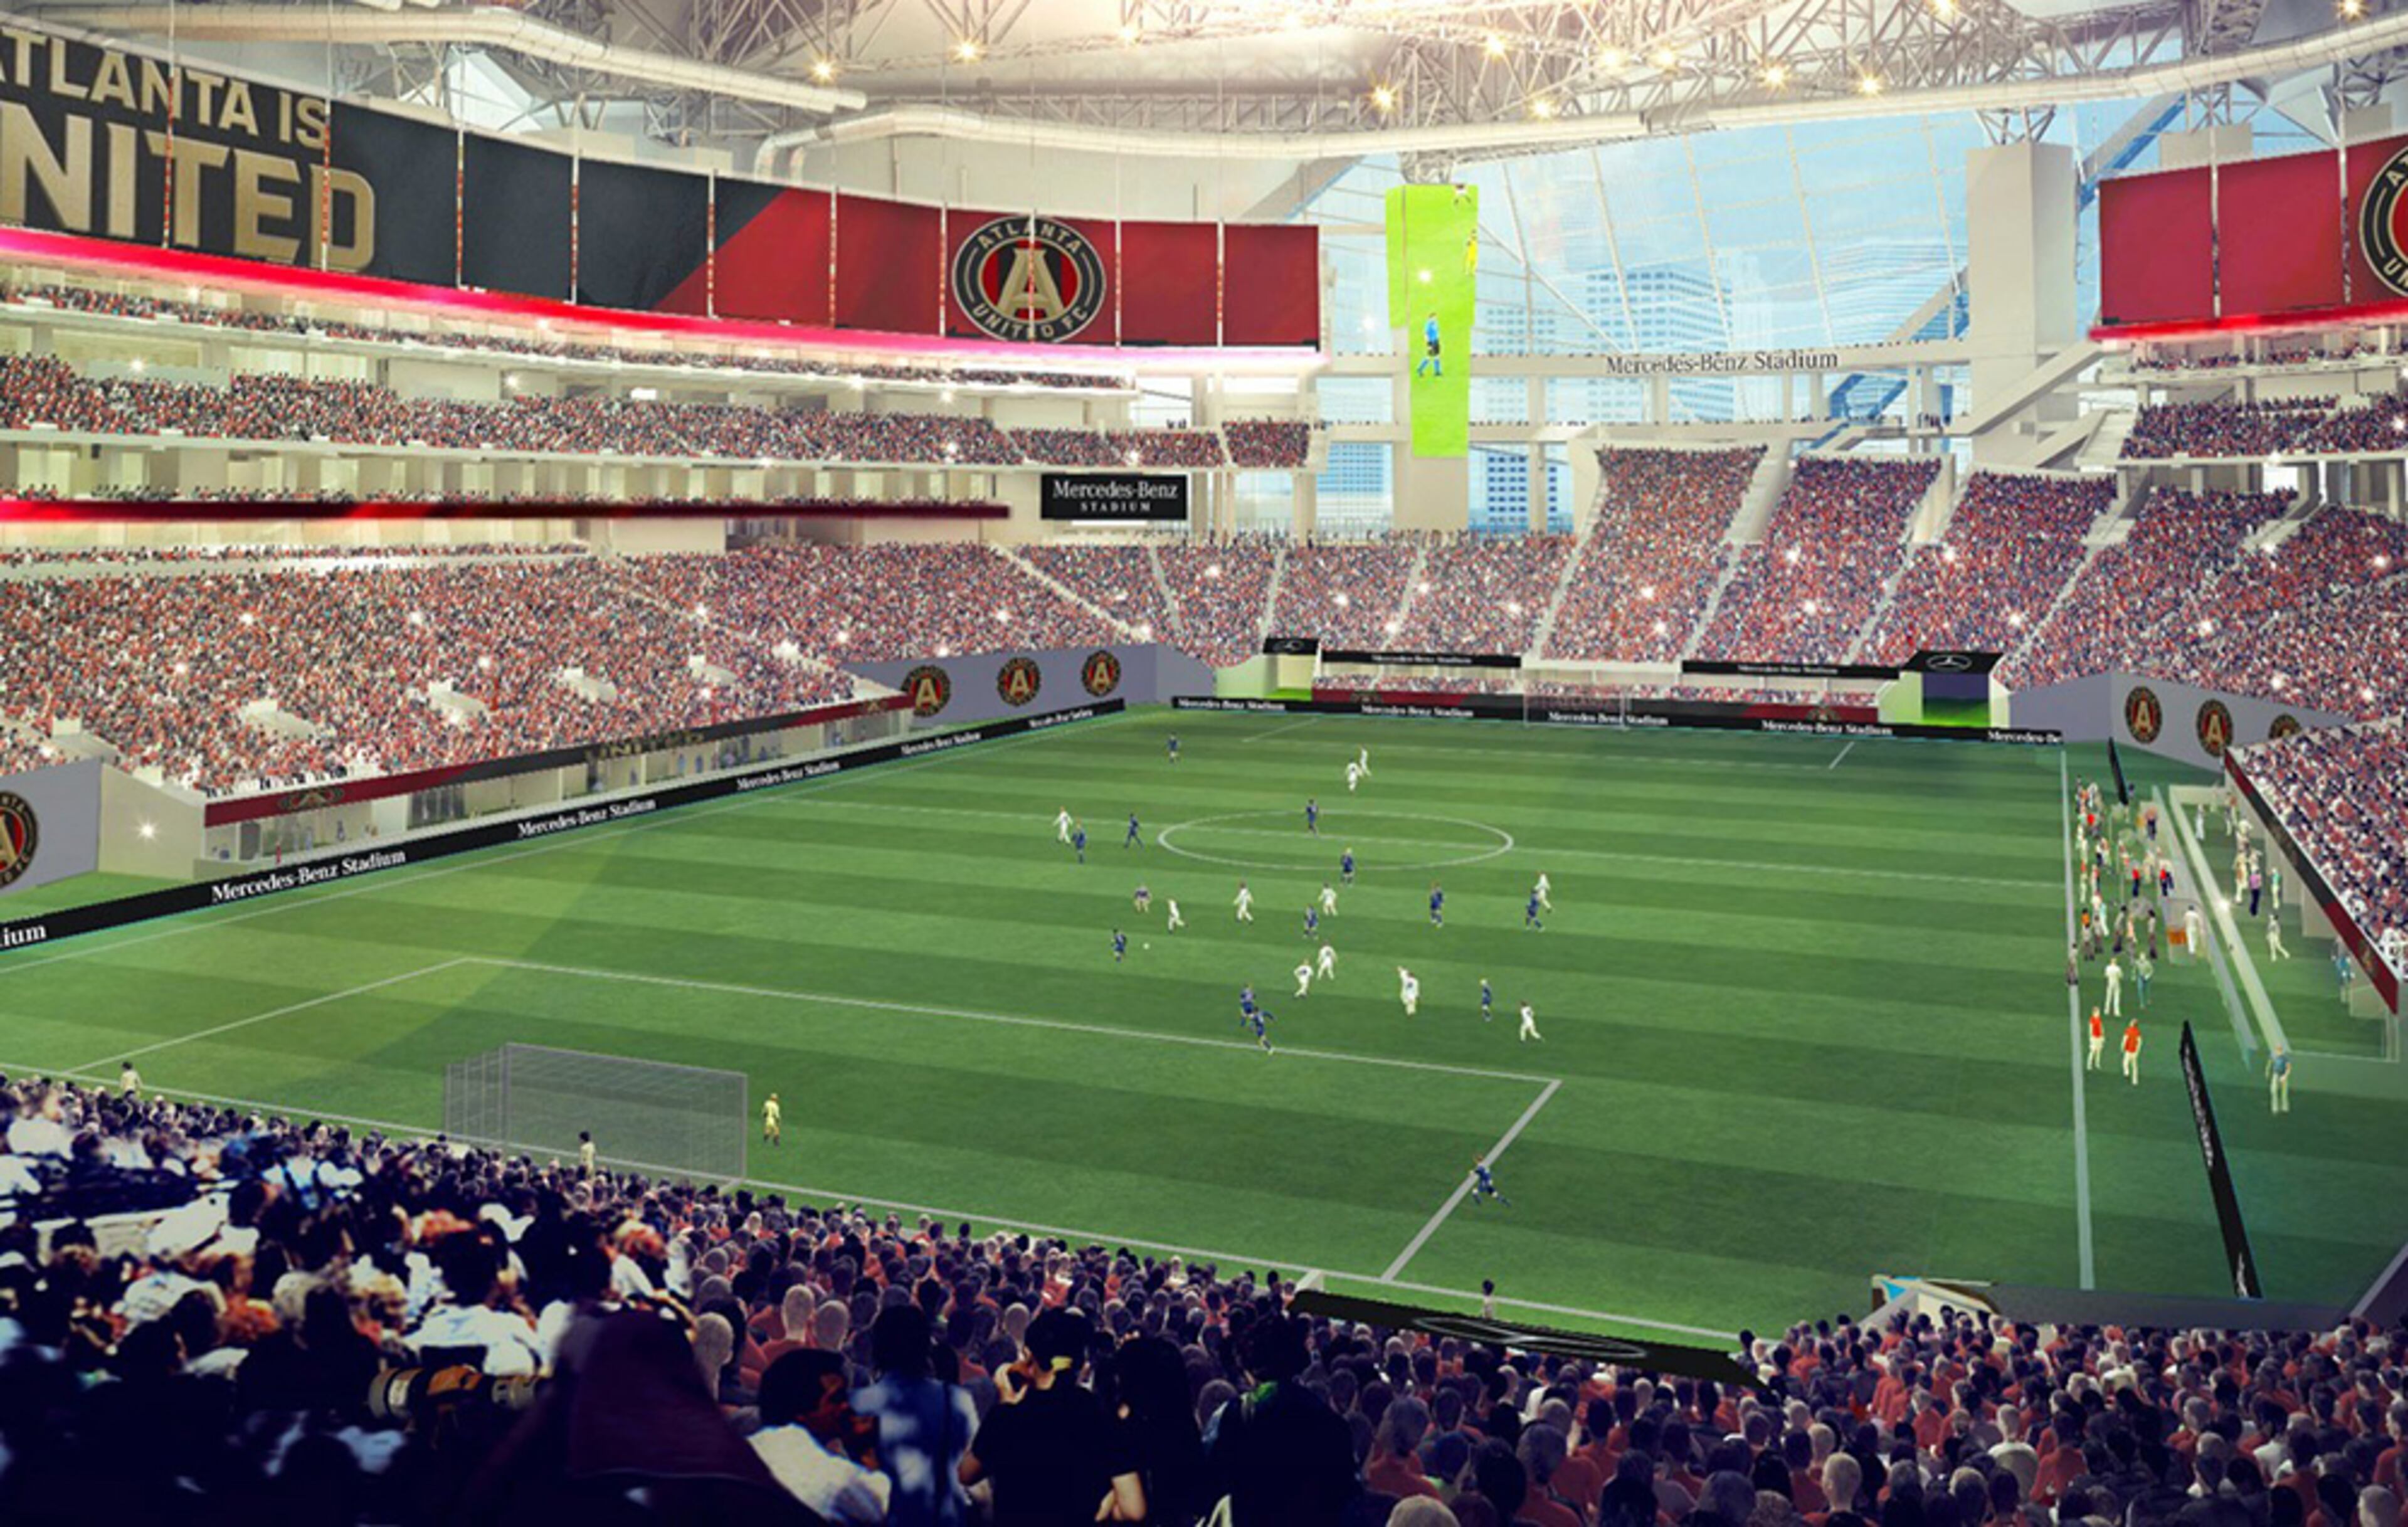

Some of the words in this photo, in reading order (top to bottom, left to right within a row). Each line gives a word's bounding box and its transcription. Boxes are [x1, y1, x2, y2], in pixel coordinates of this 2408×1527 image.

[0, 27, 258, 137] TLANTA
[280, 92, 327, 149] IS
[976, 223, 1082, 253] ATLANTA
[1062, 307, 1088, 330] FC
[1607, 352, 1748, 374] Mercedes-Benz
[1755, 350, 1838, 369] Stadium
[1053, 479, 1178, 499] Mercedes-Benz
[1080, 502, 1151, 512] STADIUM
[609, 799, 657, 816] Stadium
[211, 864, 338, 903] Mercedes-Benz
[341, 850, 406, 875] Stadium
